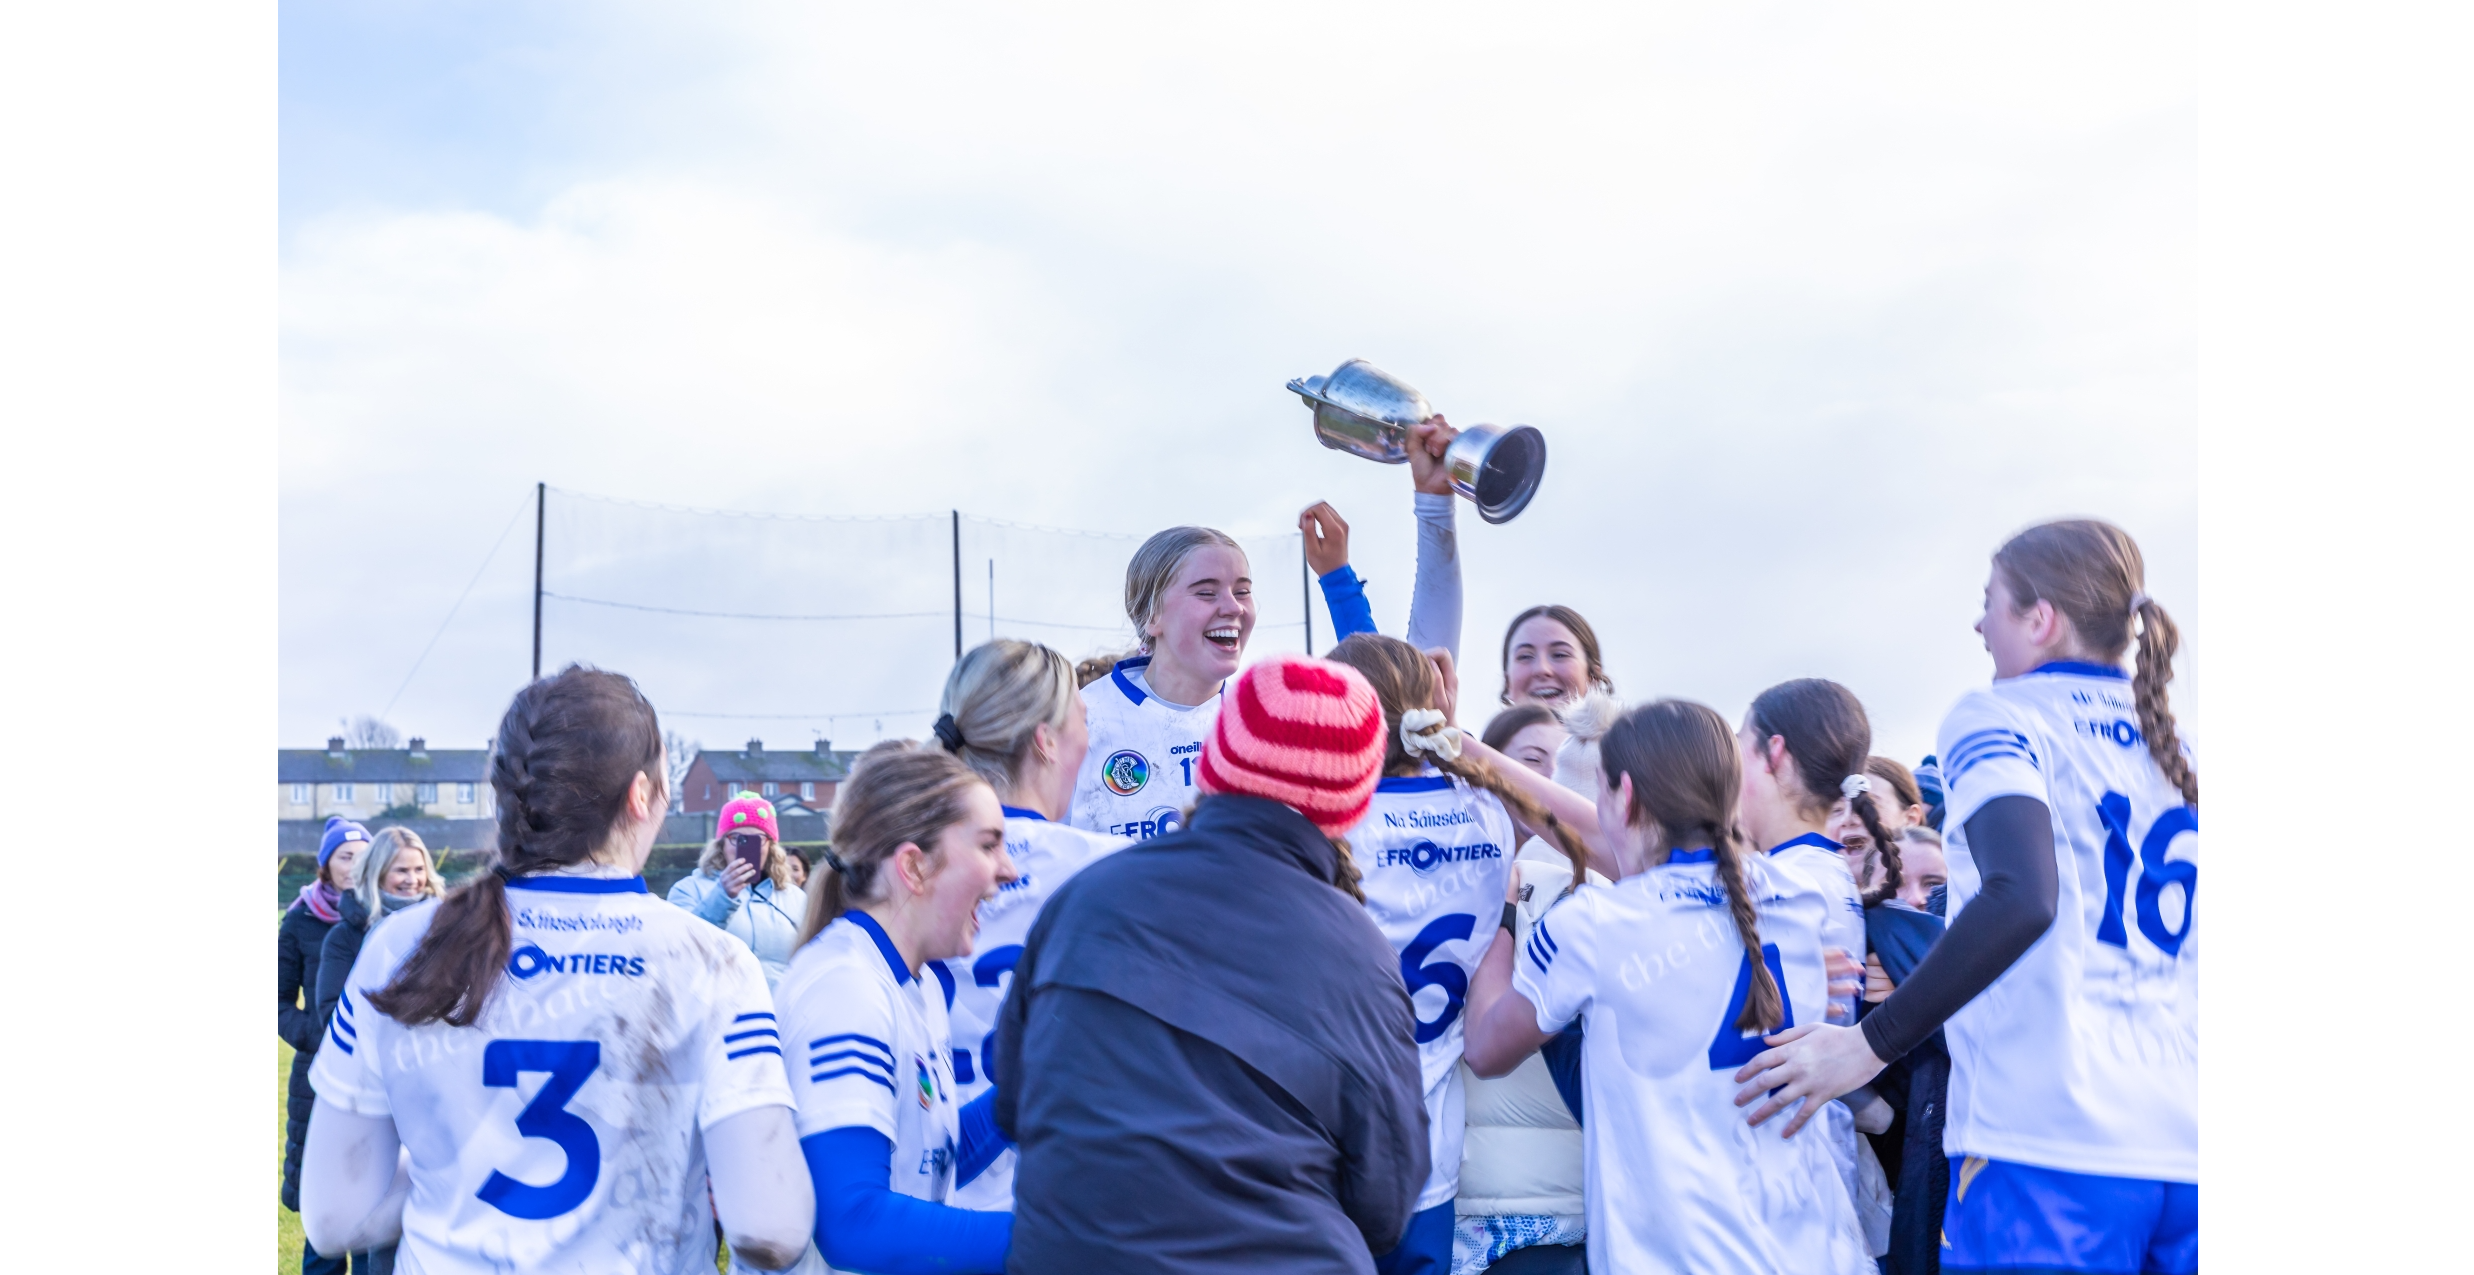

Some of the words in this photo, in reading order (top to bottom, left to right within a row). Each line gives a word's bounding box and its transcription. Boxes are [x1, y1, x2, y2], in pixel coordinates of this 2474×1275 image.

[1179, 756, 1199, 787] 1
[1384, 812, 1406, 829] Na
[1409, 808, 1476, 829] Sáirséal
[1402, 858, 1501, 917] thatc
[2096, 789, 2198, 958] 16
[509, 945, 645, 980] ONTIERS
[1400, 912, 1477, 1044] 6
[475, 1038, 600, 1220] 3
